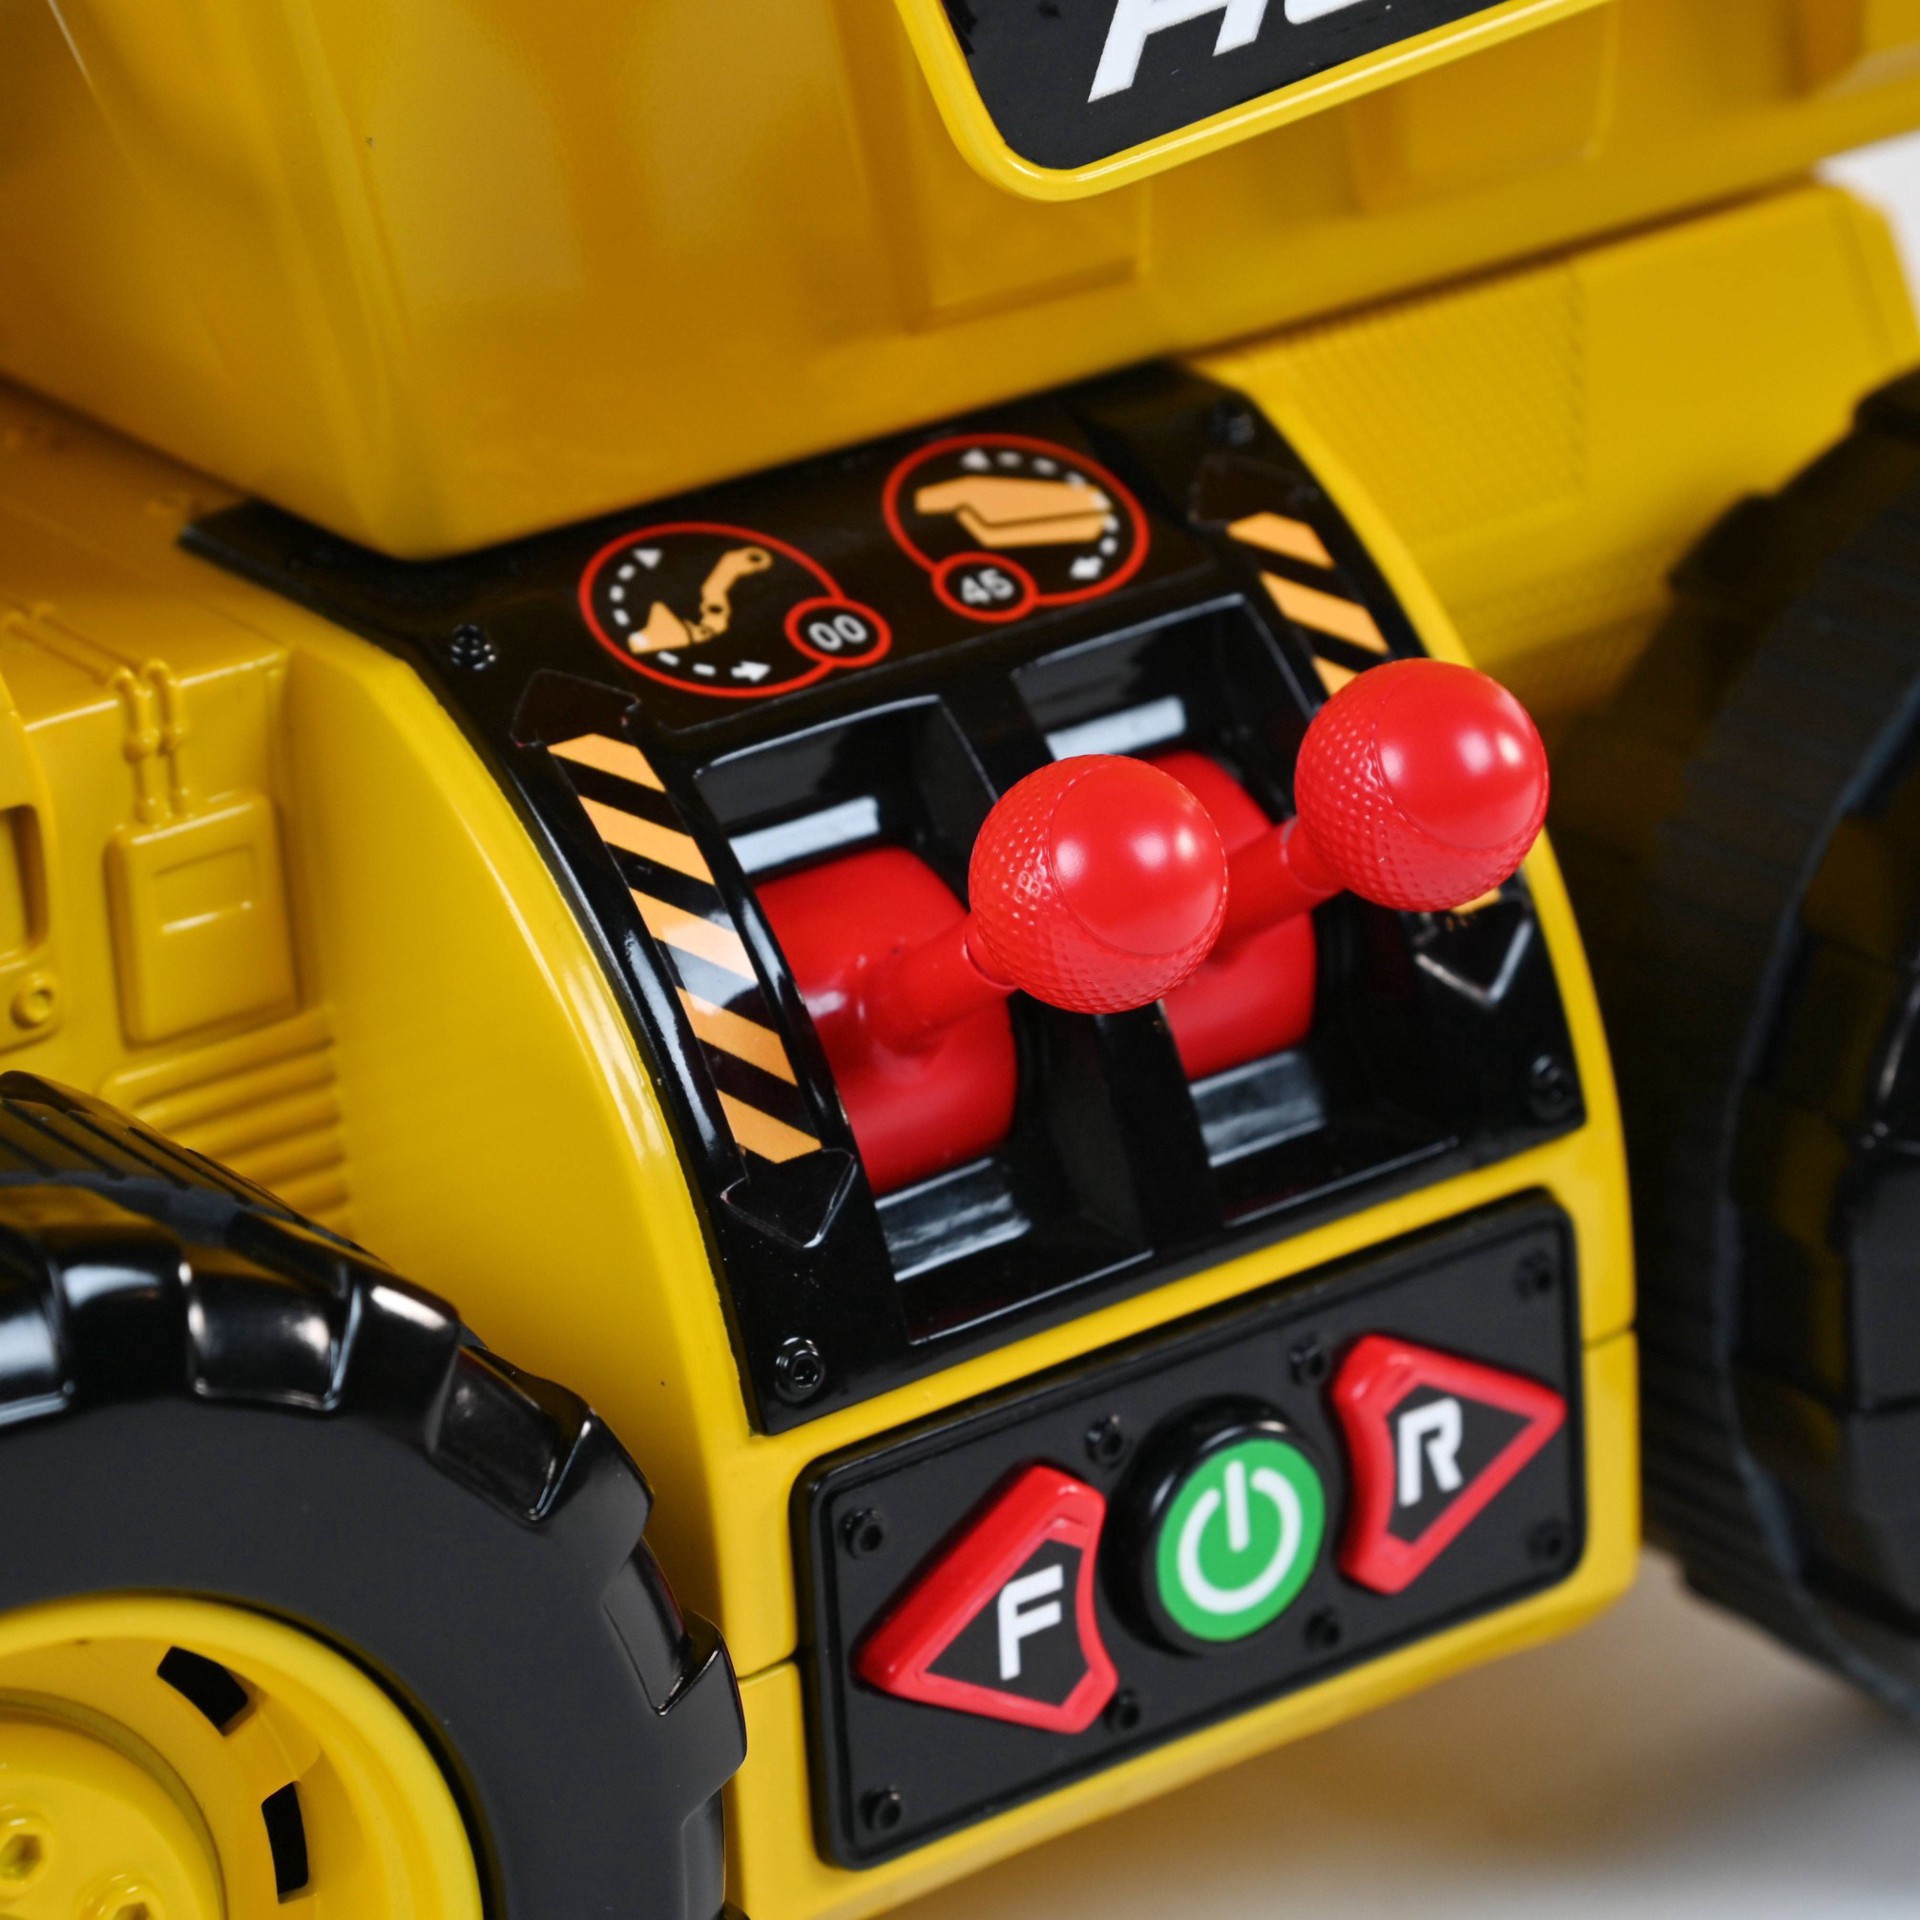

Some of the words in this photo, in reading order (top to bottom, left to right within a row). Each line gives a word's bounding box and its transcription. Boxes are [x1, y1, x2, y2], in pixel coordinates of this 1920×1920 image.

[961, 568, 1015, 604] 45
[808, 615, 867, 650] 00
[1398, 1398, 1463, 1508] R
[996, 1563, 1065, 1681] F
